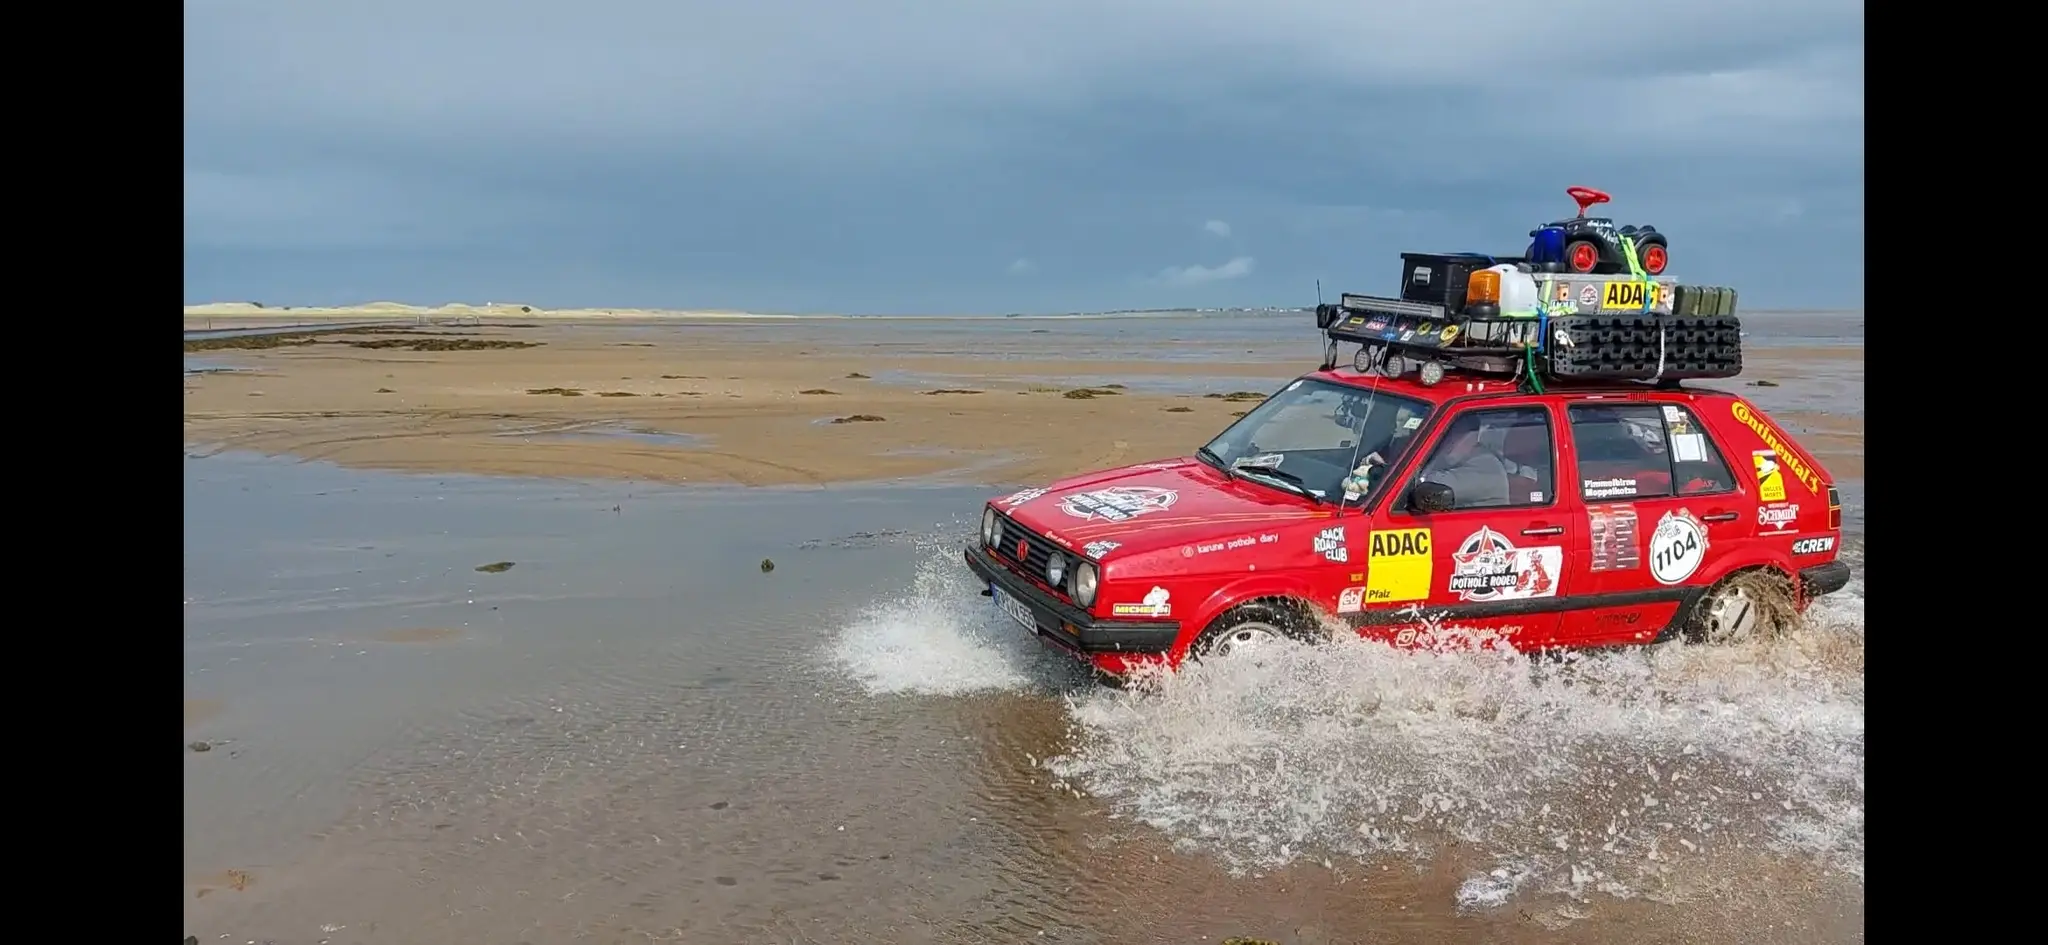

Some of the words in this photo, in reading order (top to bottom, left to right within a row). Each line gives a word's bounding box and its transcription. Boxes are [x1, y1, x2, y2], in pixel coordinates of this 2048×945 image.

[1606, 283, 1655, 305] ADA
[1732, 401, 1809, 483] Continental
[1227, 536, 1256, 551] pothole
[1260, 533, 1279, 543] diary
[1322, 527, 1345, 543] BACK
[1314, 537, 1337, 552] ROAD
[1372, 532, 1428, 557] ADAC
[1656, 531, 1697, 572] 1104
[1325, 548, 1348, 562] CLUB
[1452, 577, 1488, 588] POTHOLE
[1490, 575, 1517, 587] RODEO
[1368, 589, 1391, 599] Pfalz
[1499, 624, 1524, 635] diary
